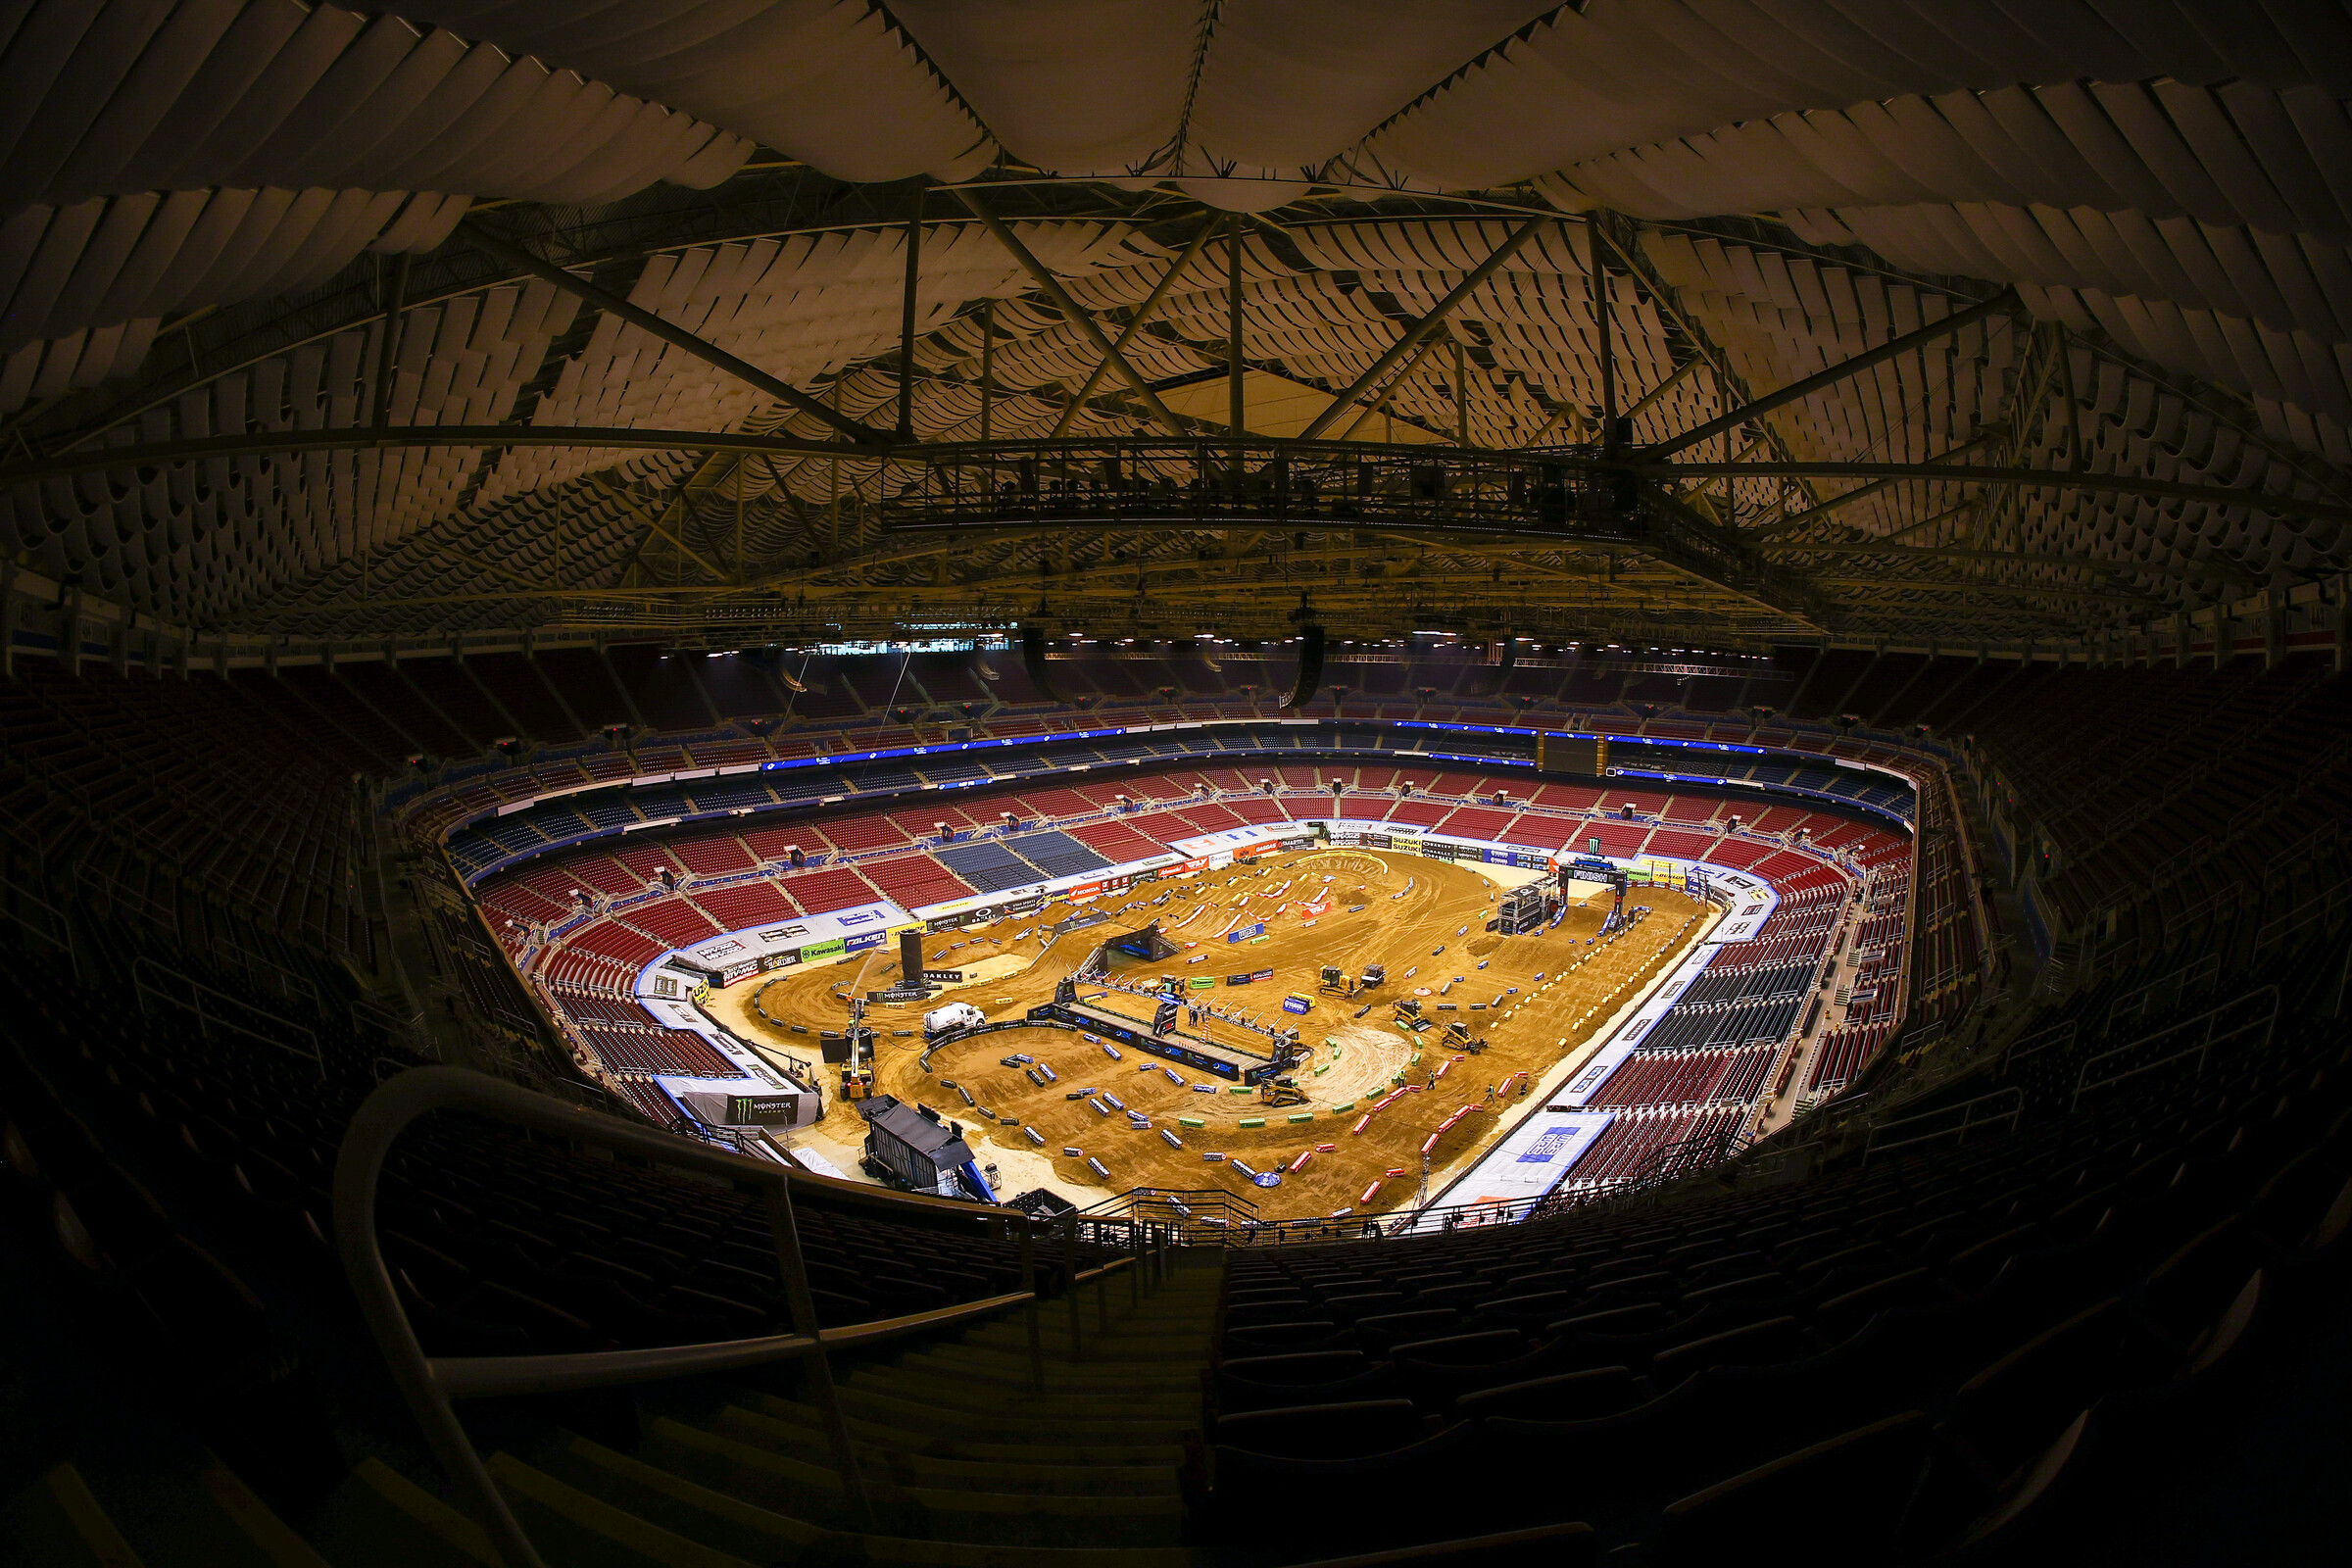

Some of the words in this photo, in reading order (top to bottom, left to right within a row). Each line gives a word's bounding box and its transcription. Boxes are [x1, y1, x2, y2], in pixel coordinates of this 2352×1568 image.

[1393, 837, 1421, 846] SUZUKI
[1393, 844, 1421, 853] SUZUKI
[1573, 870, 1608, 882] FINISH
[1077, 886, 1100, 896] HONDA
[847, 932, 885, 947] FALKEN
[810, 944, 845, 957] Kawasaki
